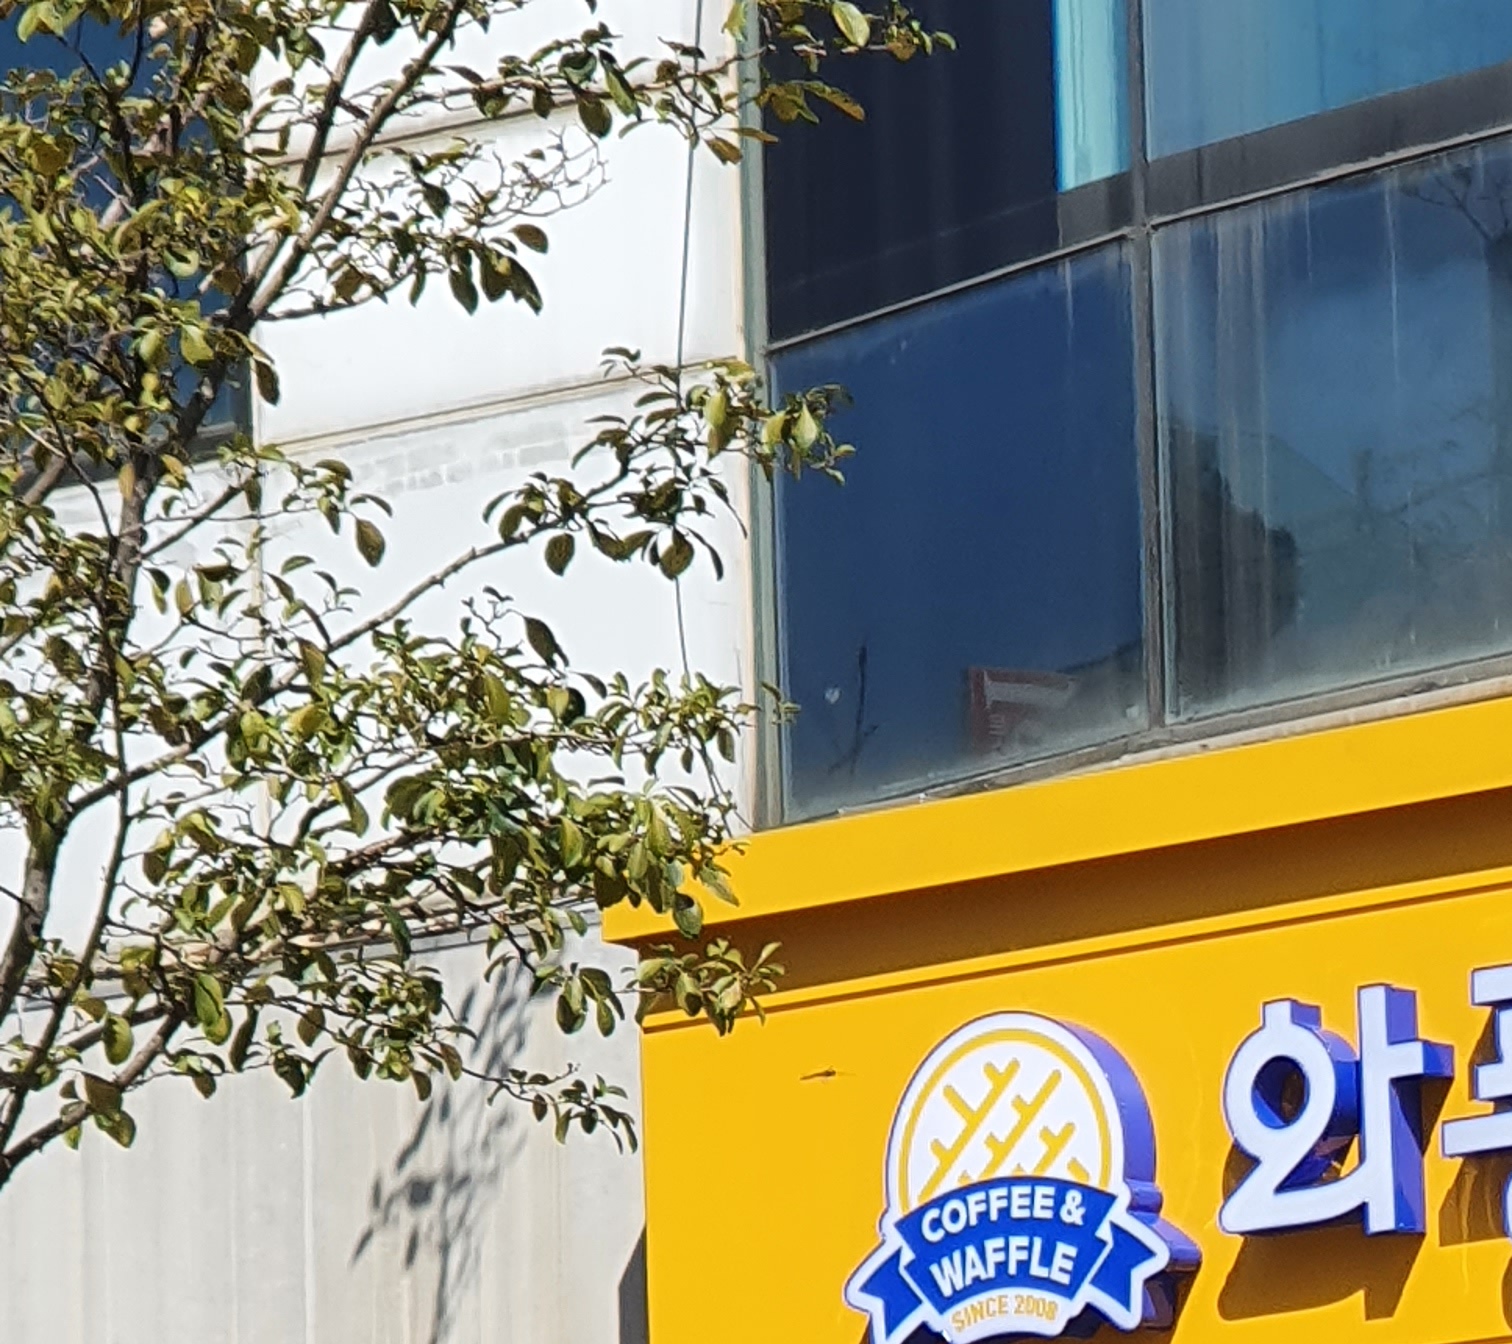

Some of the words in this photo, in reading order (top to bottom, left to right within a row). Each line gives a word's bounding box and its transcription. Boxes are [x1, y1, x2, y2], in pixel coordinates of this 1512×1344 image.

[921, 1185, 1055, 1243] COFFEE
[1060, 1189, 1084, 1226] &
[929, 1236, 1078, 1298] WAFFLE
[950, 1295, 1009, 1332] SINCE
[1013, 1294, 1058, 1321] 2008
